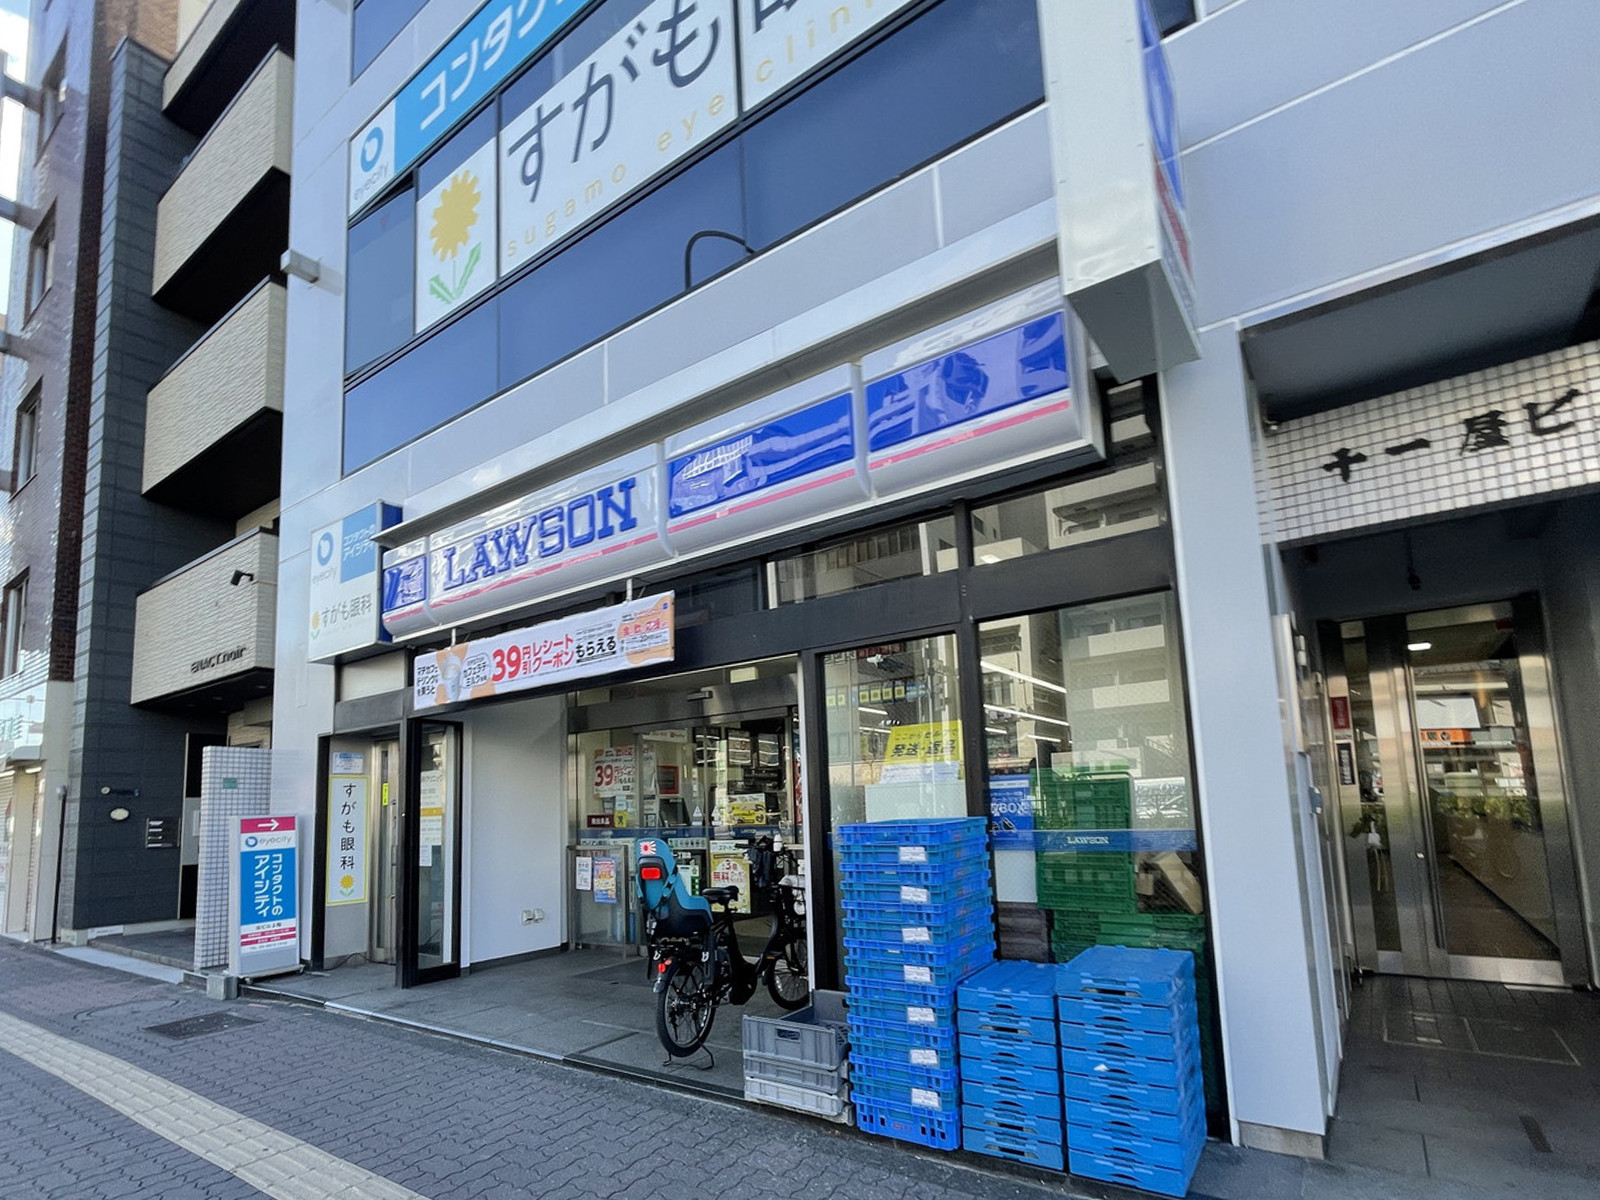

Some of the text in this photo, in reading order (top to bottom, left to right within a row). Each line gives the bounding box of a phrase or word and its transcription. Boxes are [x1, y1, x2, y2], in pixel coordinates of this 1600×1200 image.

[420, 0, 563, 131] コンタク
[507, 163, 627, 258] sugamo
[657, 94, 725, 152] eye
[443, 476, 638, 591] LAWSON
[321, 592, 373, 628] すがも眼科
[491, 644, 521, 682] 39
[532, 633, 574, 657] レシート
[532, 650, 575, 675] クーポン
[575, 635, 617, 659] もらえる
[594, 764, 614, 788] 39
[340, 782, 357, 871] すがも眼科
[253, 854, 270, 918] アイシティ
[271, 853, 283, 917] コンタクトの
